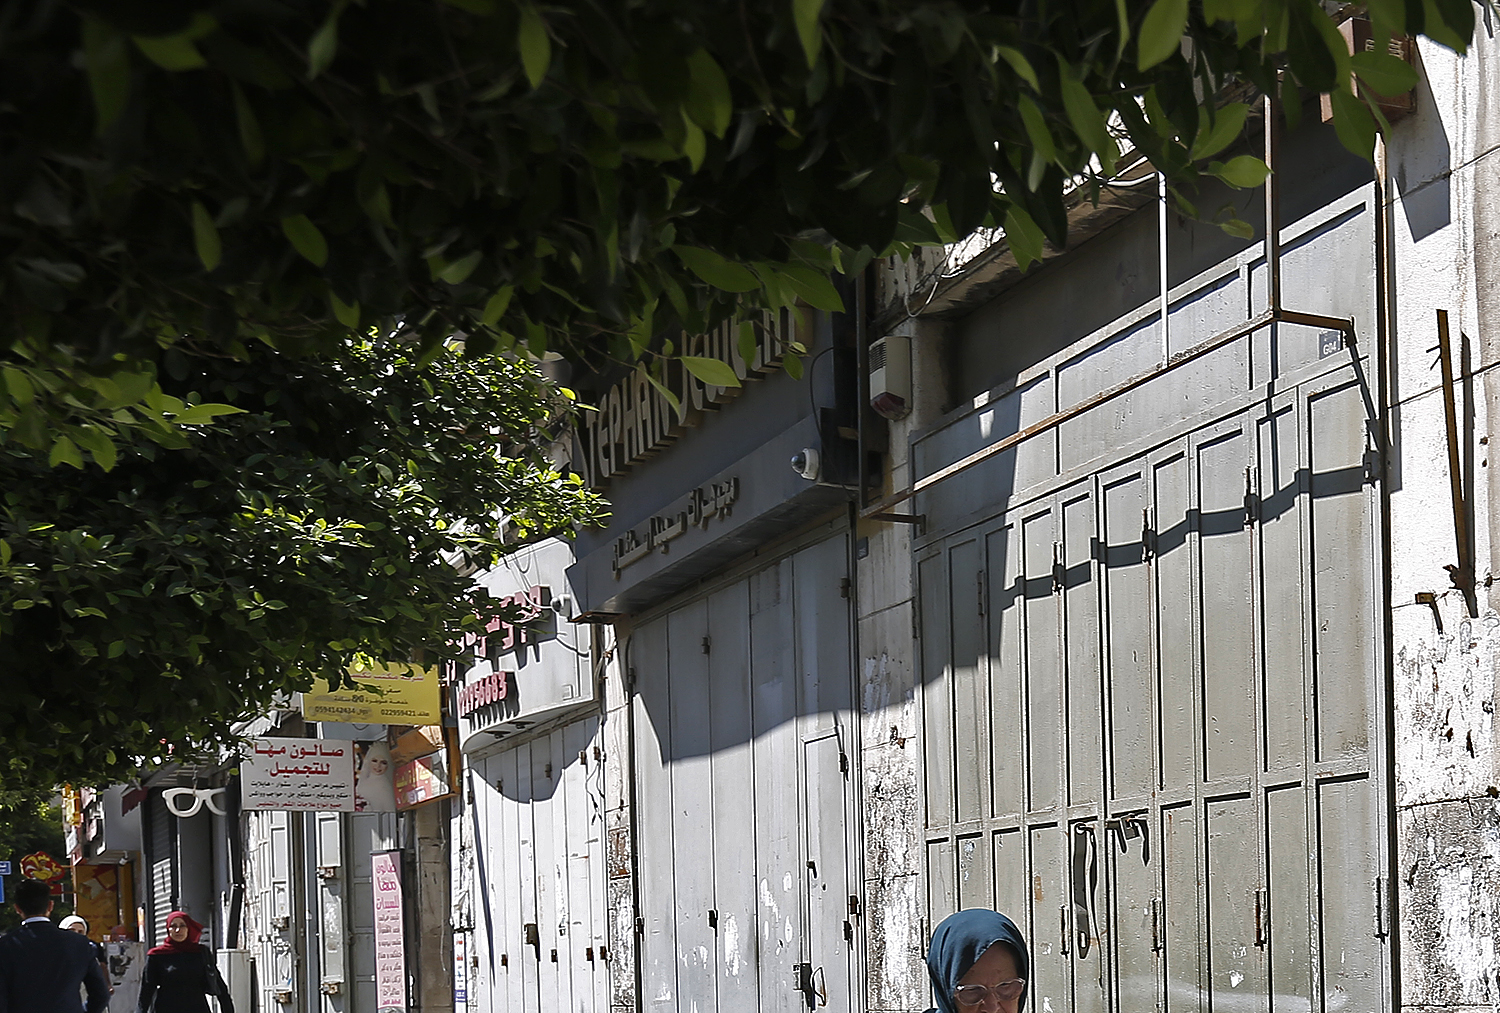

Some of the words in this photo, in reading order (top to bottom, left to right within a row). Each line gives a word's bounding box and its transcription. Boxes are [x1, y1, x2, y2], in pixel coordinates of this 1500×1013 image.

[254, 742, 286, 758] مها
[290, 743, 344, 759] صالون
[269, 761, 330, 778] للتجميل
